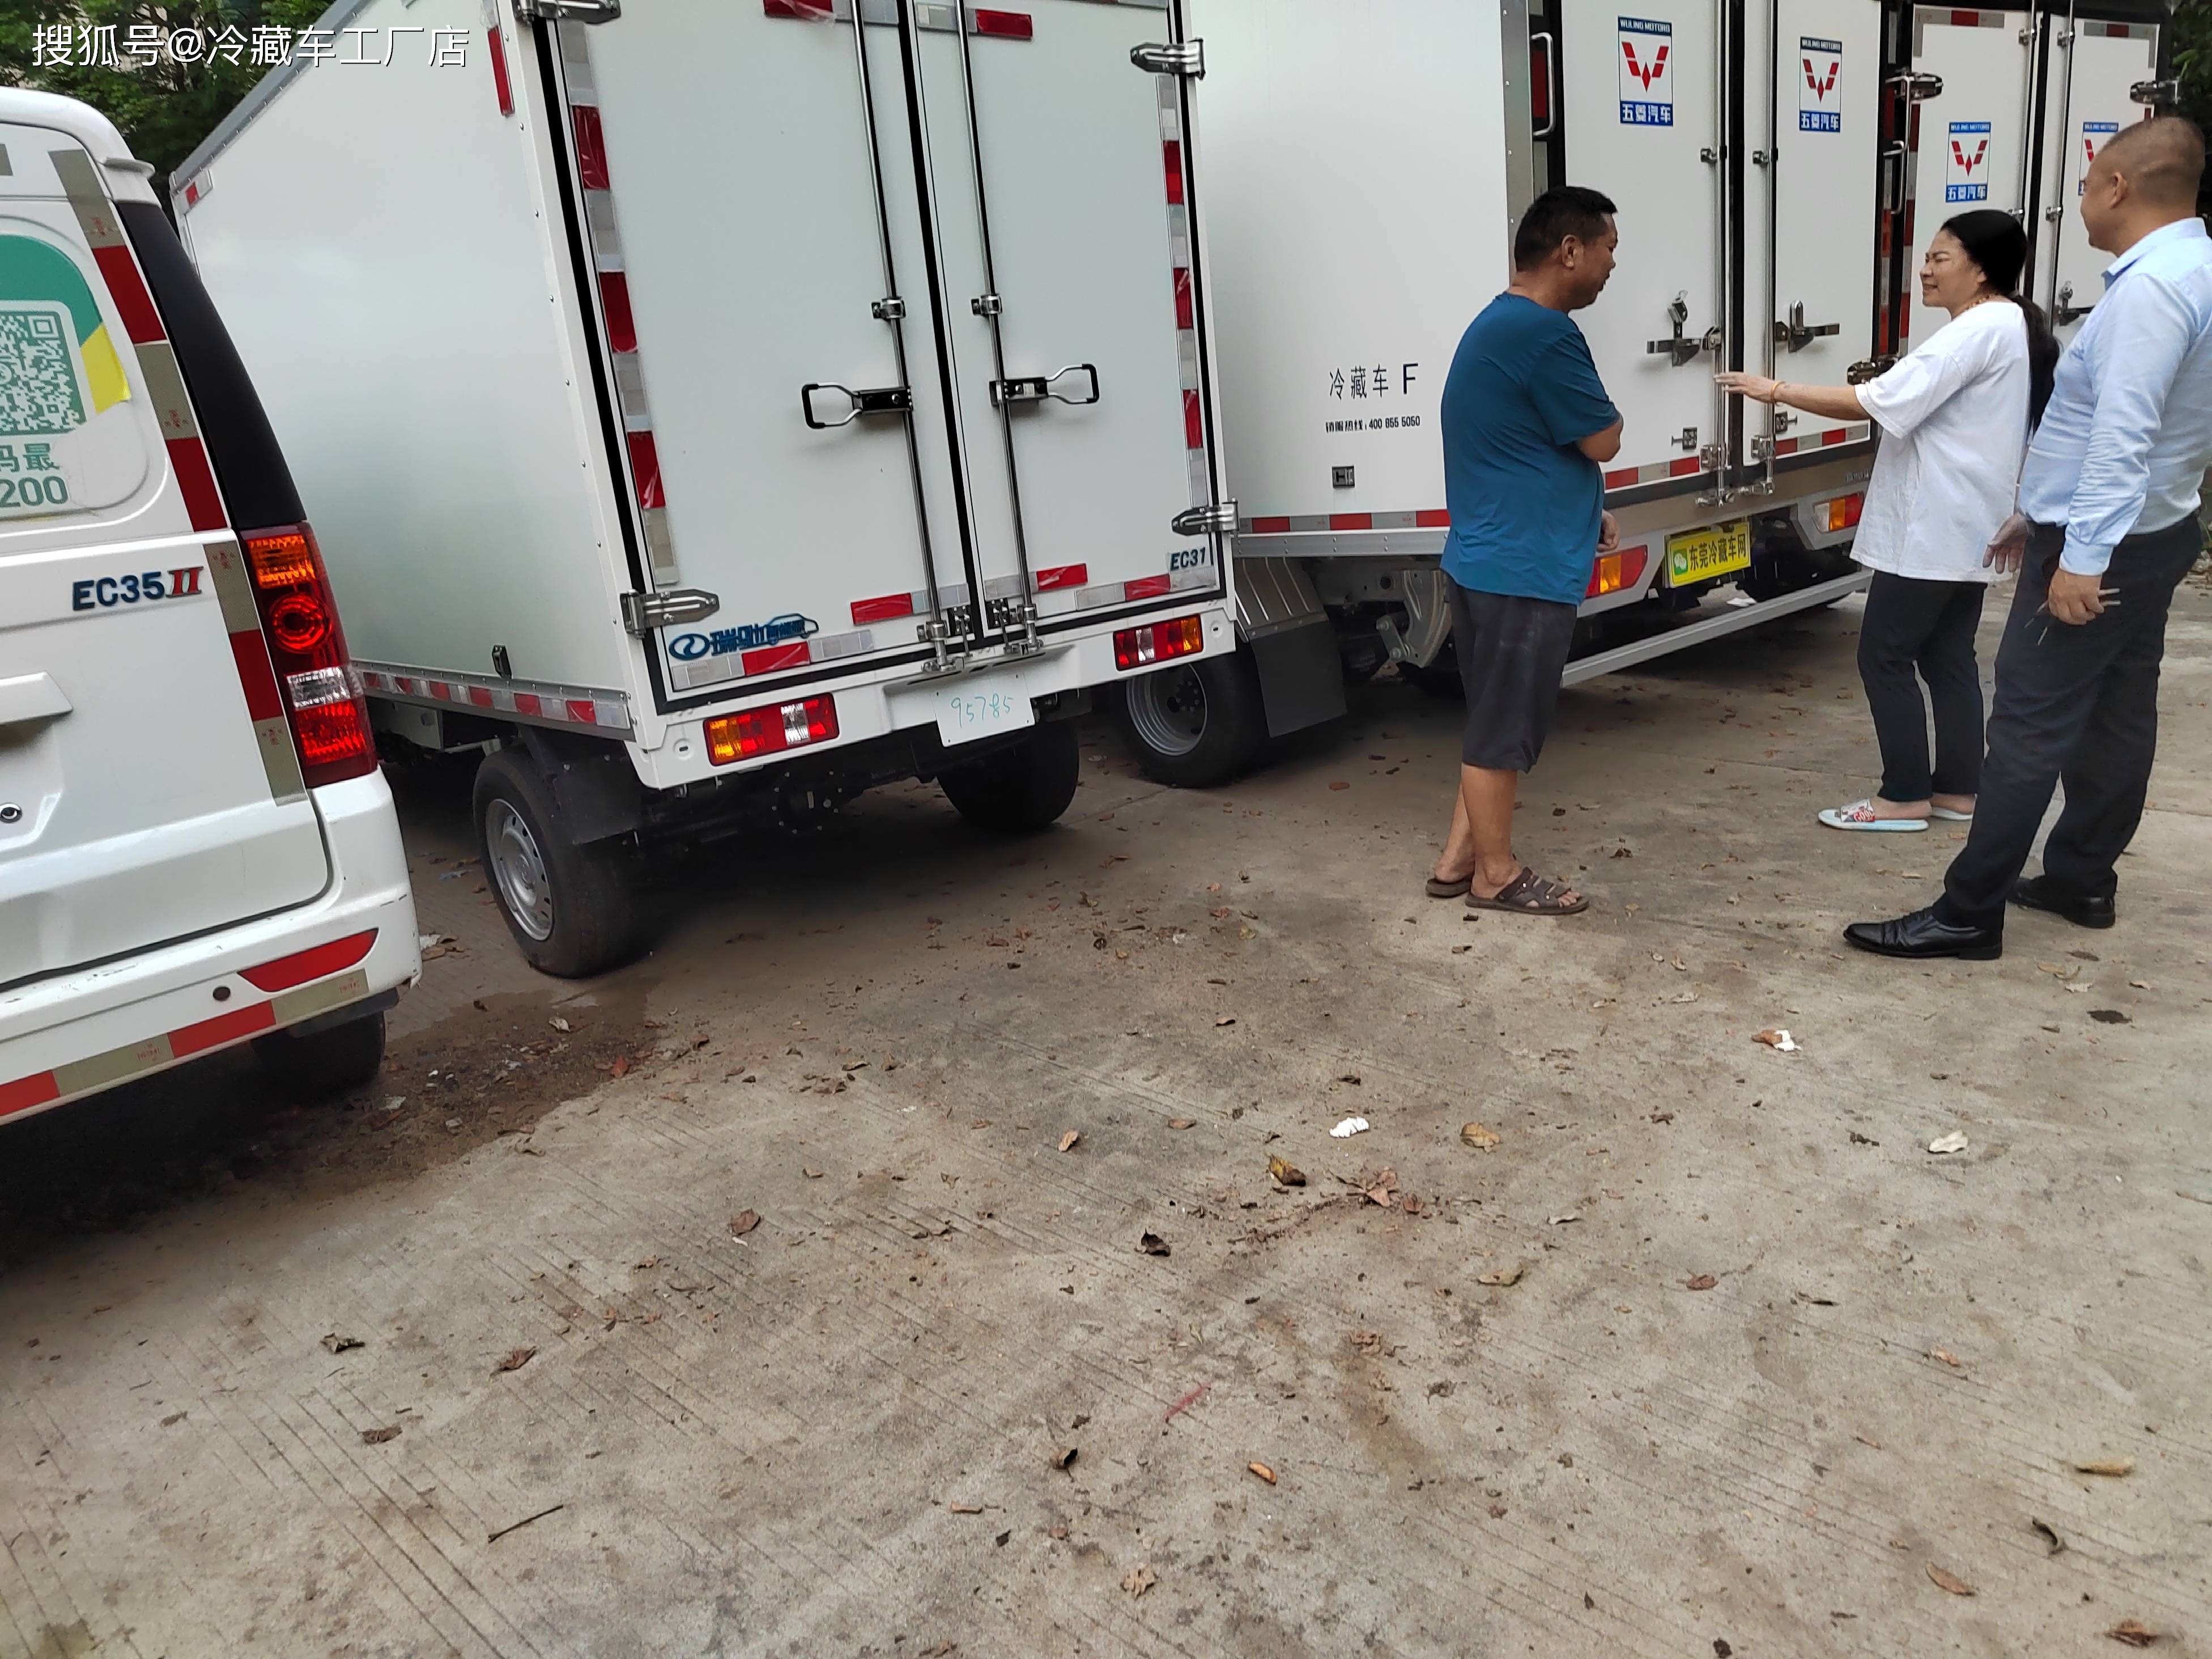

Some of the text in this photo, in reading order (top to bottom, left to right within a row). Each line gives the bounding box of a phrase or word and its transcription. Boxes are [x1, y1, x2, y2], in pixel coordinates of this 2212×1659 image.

[1329, 363, 1418, 400] 冷藏车 F
[1368, 418, 1382, 430] 400
[1169, 547, 1206, 571] EC31
[1688, 533, 1747, 572] 东莞冷藏车网
[951, 693, 1014, 728] 95785
